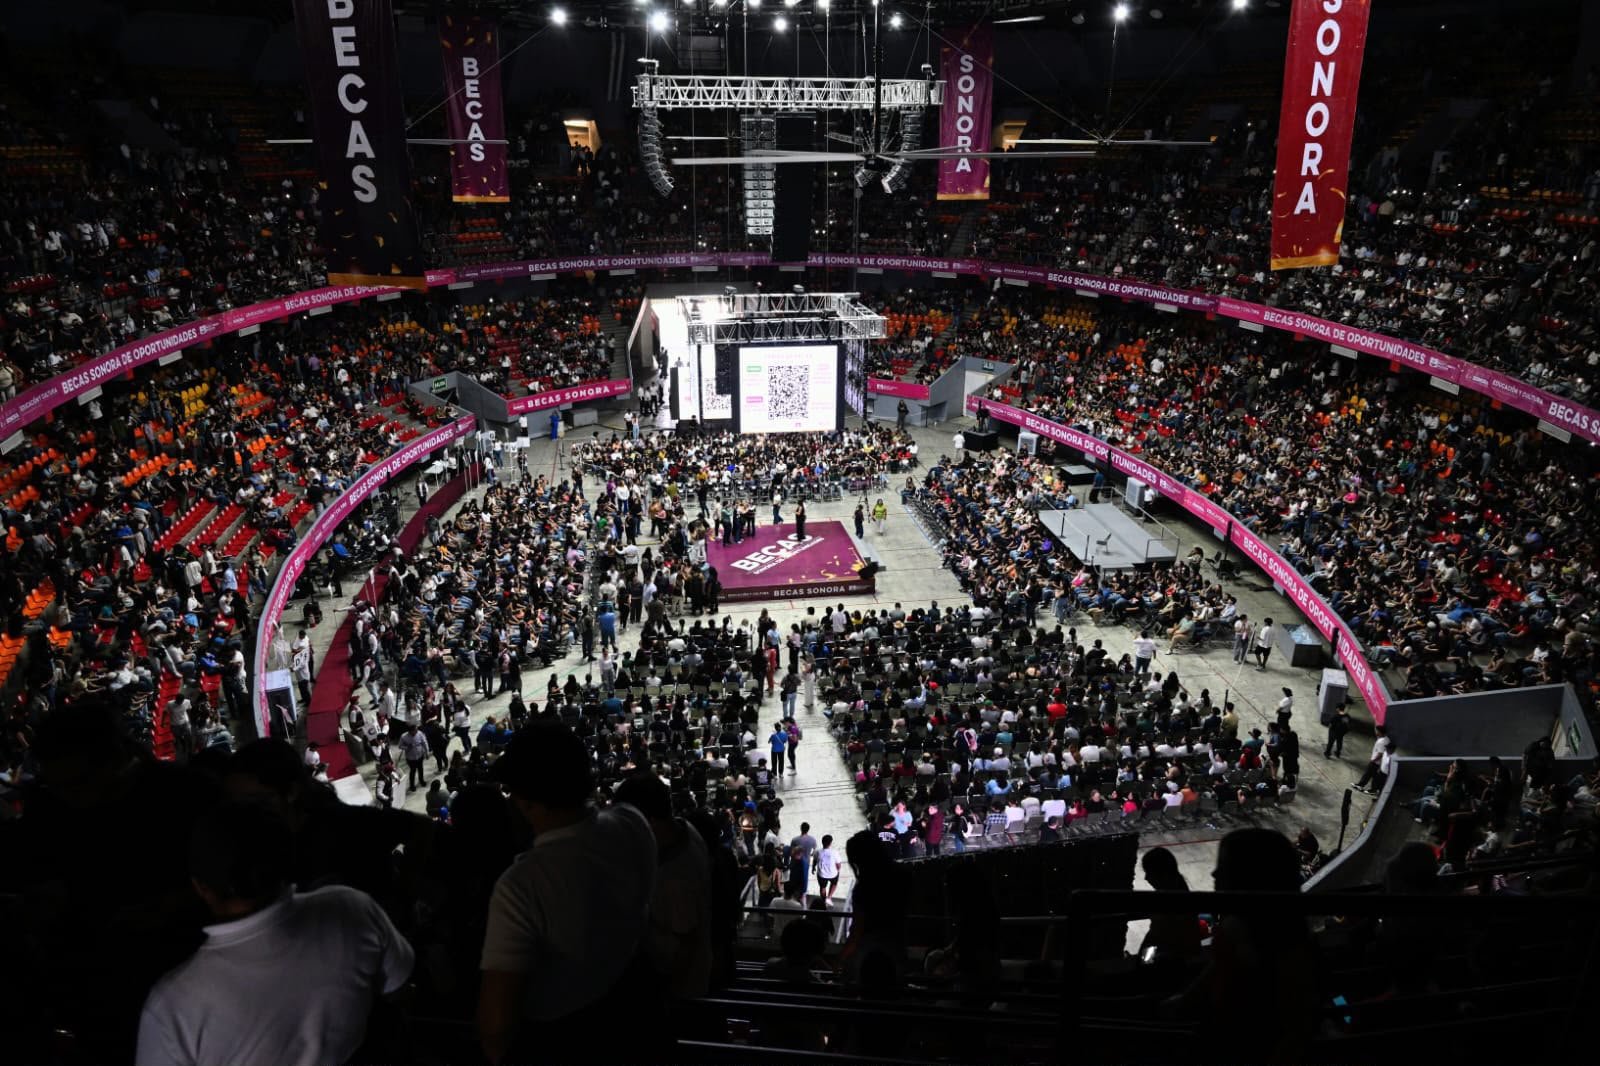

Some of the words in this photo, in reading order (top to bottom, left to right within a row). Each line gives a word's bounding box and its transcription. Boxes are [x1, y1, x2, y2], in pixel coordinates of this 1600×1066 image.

[462, 57, 487, 162] BECAS
[955, 54, 975, 173] SONORA
[528, 262, 558, 273] BECAS
[559, 258, 596, 270] SONORA
[597, 257, 610, 267] DE
[611, 255, 687, 267] OPORTUNIDADES
[825, 256, 862, 266] SONORA
[863, 257, 876, 266] DE
[877, 257, 949, 269] OPORTUNIDADES
[284, 297, 310, 311] BECAS
[311, 290, 343, 304] SONORA
[344, 287, 355, 297] DE
[1047, 272, 1073, 285] BECAS
[1074, 276, 1107, 291] SONORA
[1109, 283, 1121, 293] DE
[1121, 284, 1189, 305] OPORTUNIDADES
[1263, 310, 1294, 327] BECAS
[1295, 317, 1331, 338] SONORA
[1332, 328, 1346, 341] DE
[1347, 332, 1426, 366] OPORTUNIDADES
[61, 370, 90, 395] BECAS
[89, 356, 122, 381] SONORA
[121, 352, 133, 366] DE
[132, 328, 198, 360] OPORTUNIDADES
[527, 394, 561, 409] BECAS
[565, 385, 610, 400] SONORA
[1025, 416, 1050, 434] BECAS
[1050, 426, 1084, 447] SONORA
[1084, 438, 1096, 451] DE
[1547, 401, 1590, 430] BECAS
[1590, 418, 1600, 438] S
[349, 482, 368, 506] BECAS
[392, 458, 401, 471] DE
[401, 428, 454, 464] OPORTUNIDADES
[730, 533, 813, 571] BECAS
[1242, 536, 1268, 564] BECAS
[1268, 556, 1298, 596] SONORA
[1297, 588, 1309, 607] DE
[773, 589, 805, 598] BECAS
[808, 587, 846, 596] SONORA
